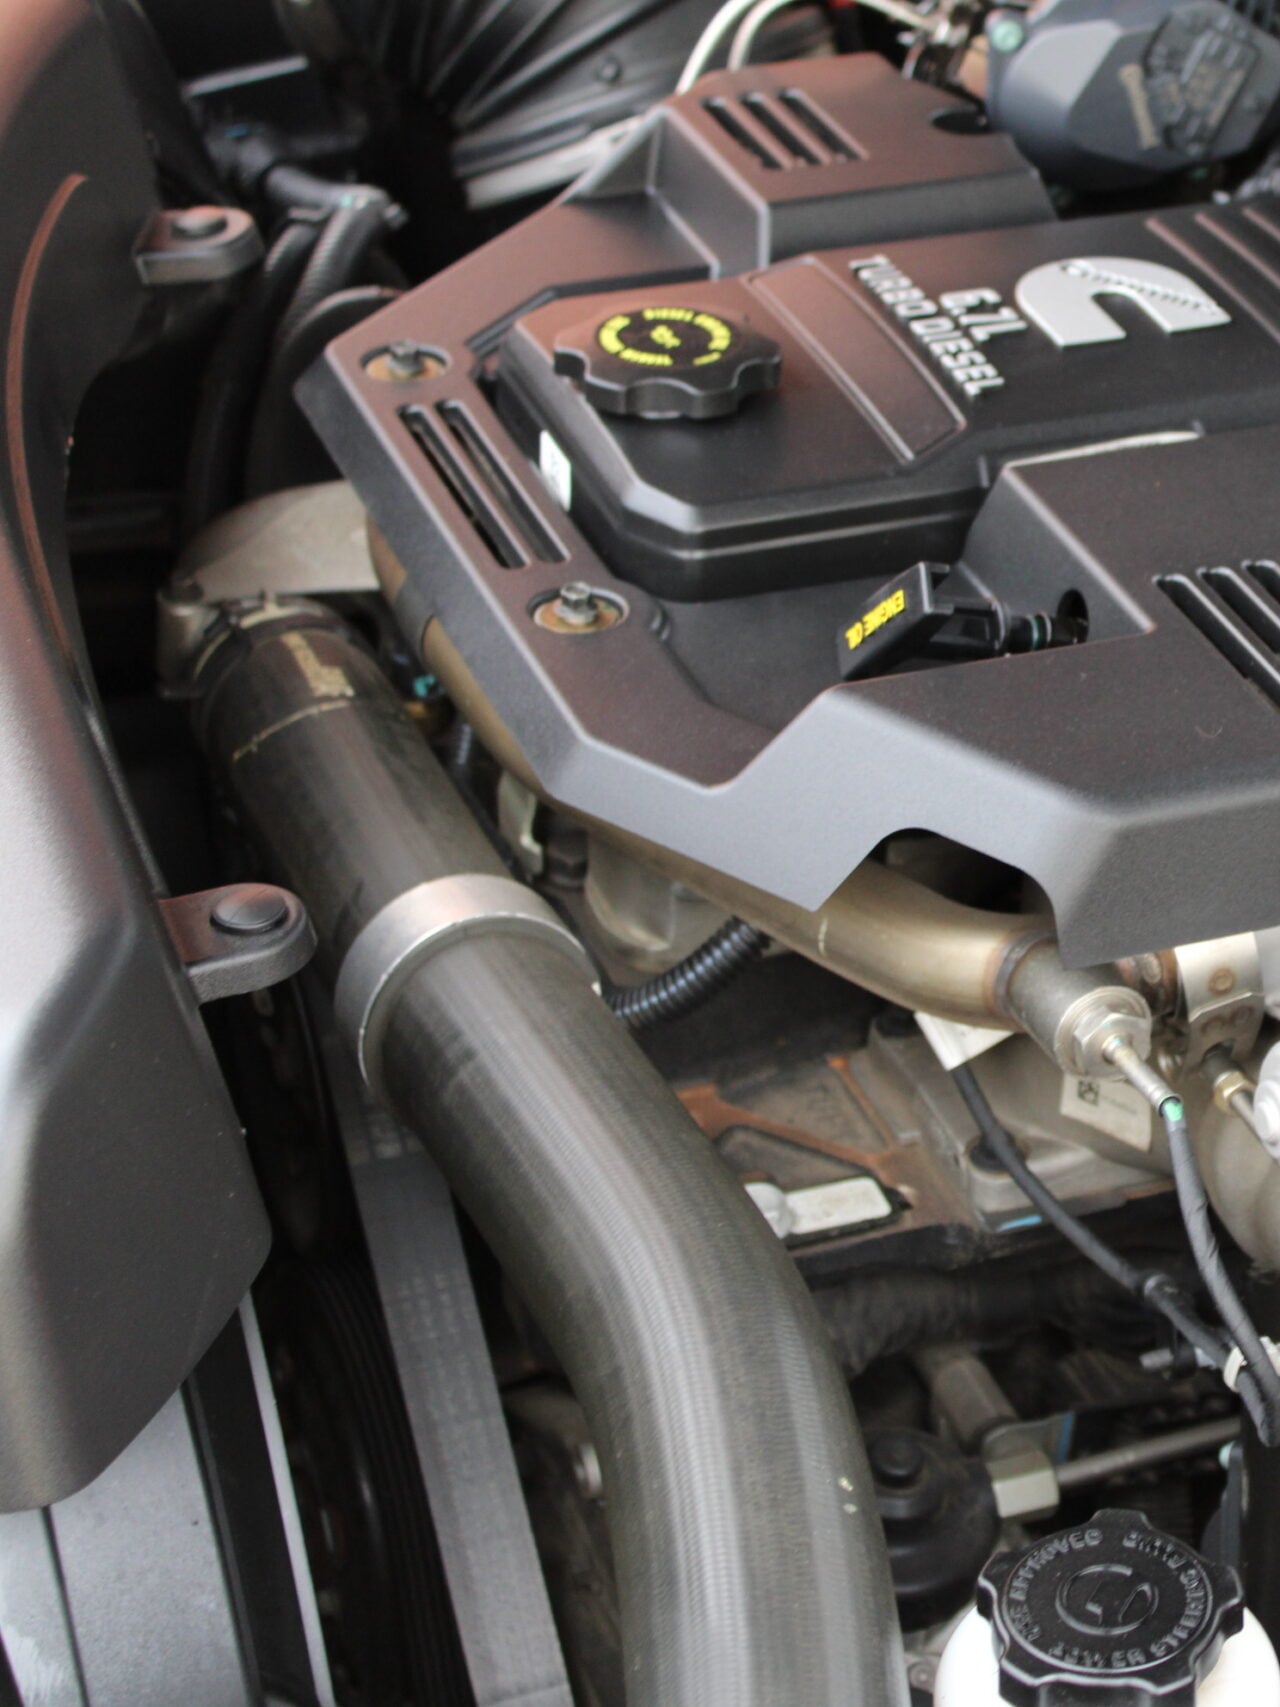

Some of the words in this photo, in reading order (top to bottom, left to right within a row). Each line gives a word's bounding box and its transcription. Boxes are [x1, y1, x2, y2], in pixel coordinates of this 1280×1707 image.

[847, 253, 938, 317] TURBO
[908, 315, 1005, 397] DIESEL
[938, 287, 1028, 343] 6.7L
[845, 621, 864, 651] OIL
[862, 588, 906, 638] ENGINE
[1008, 1527, 1104, 1602] APPROVED
[1148, 1568, 1207, 1658] STEERING
